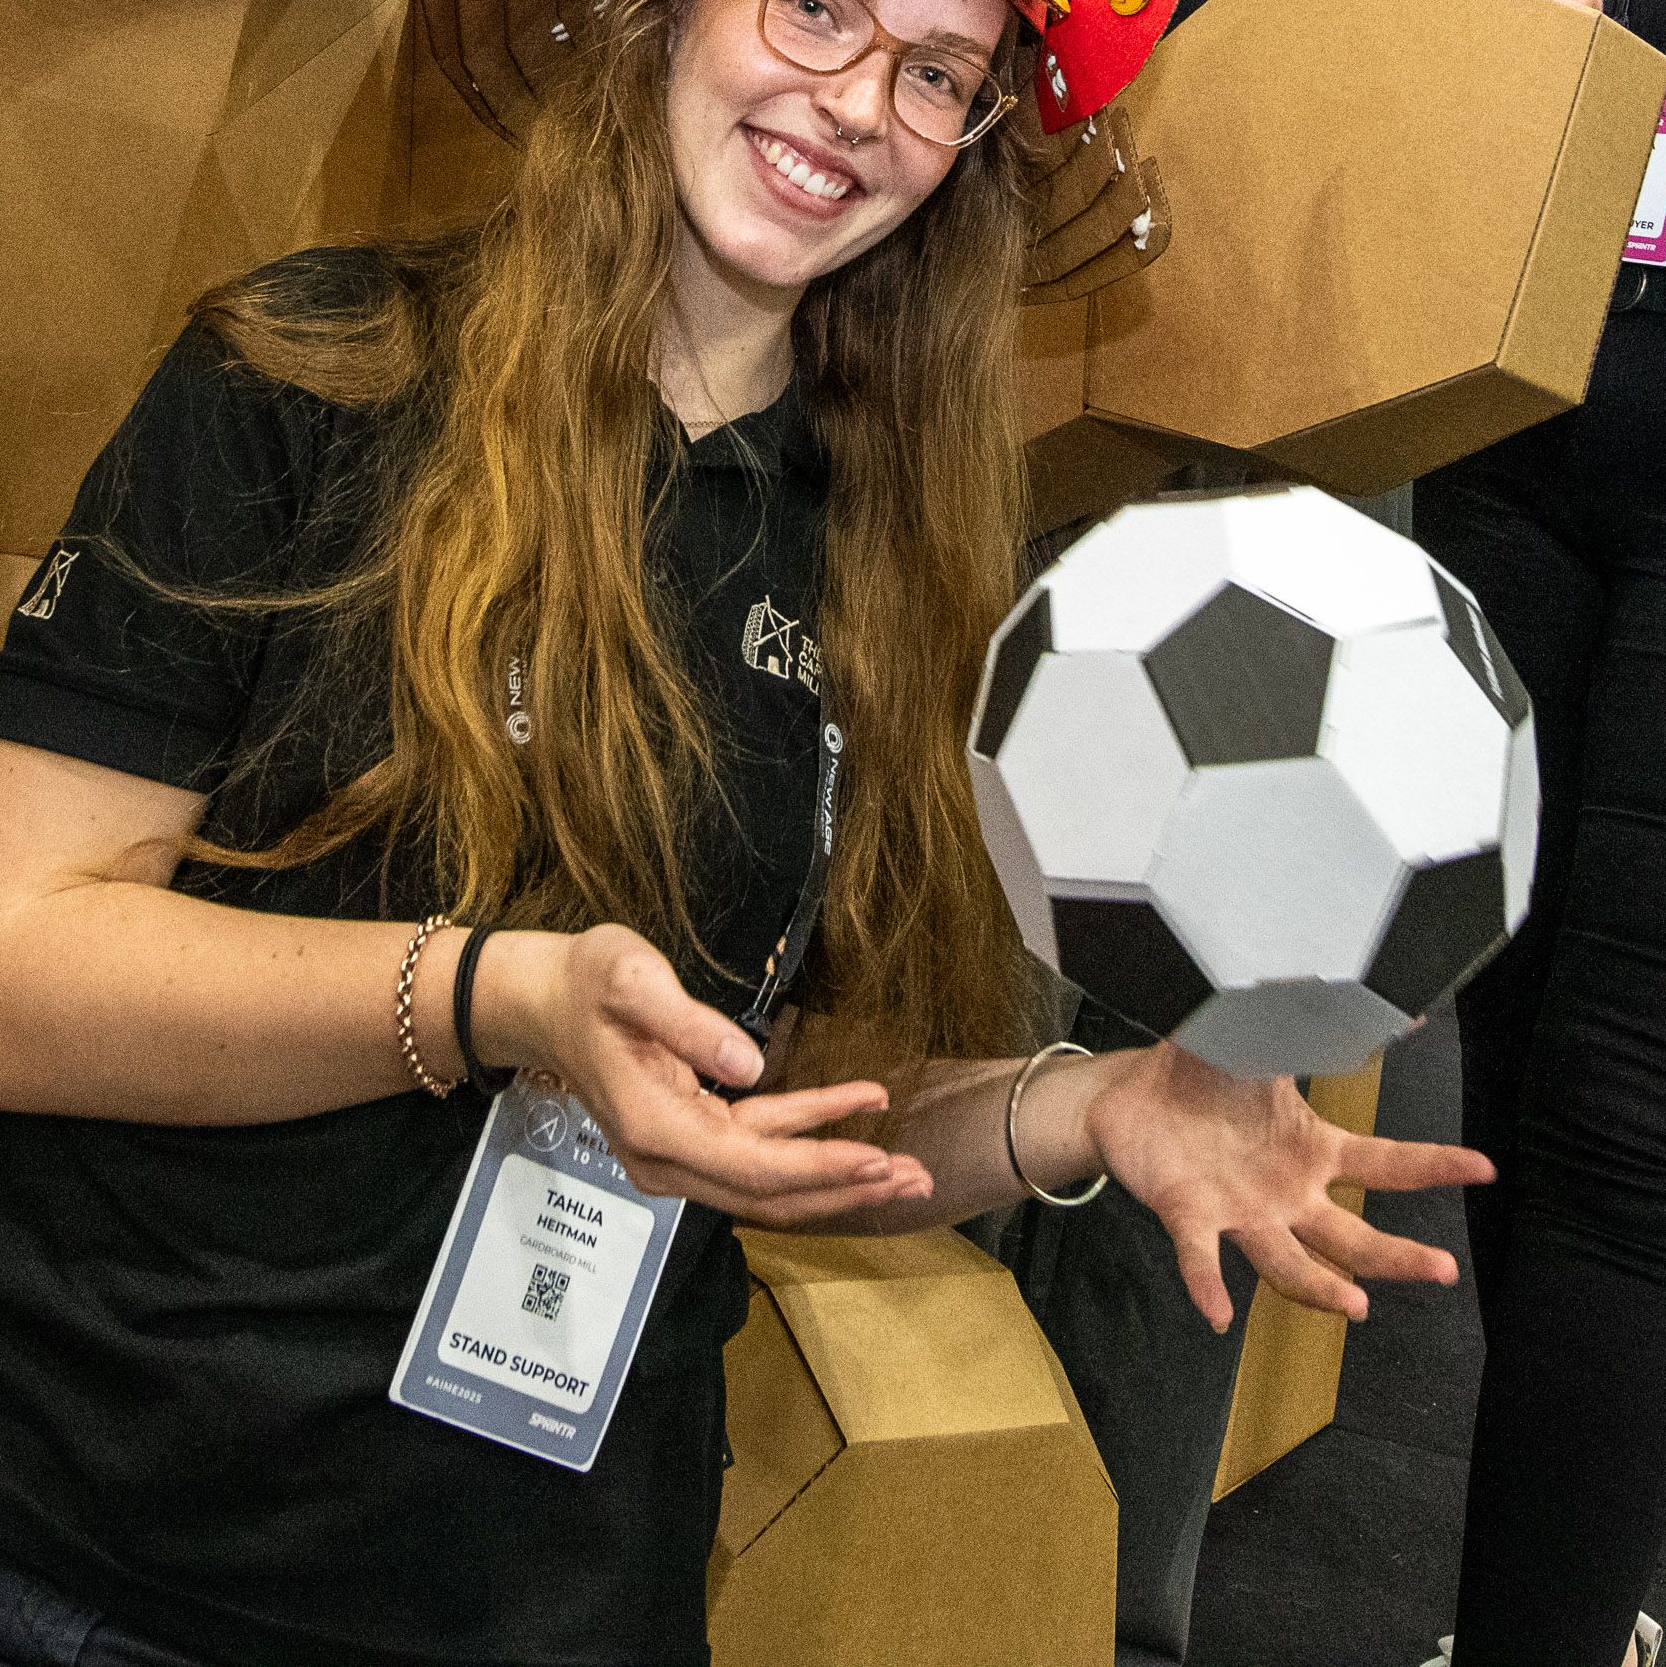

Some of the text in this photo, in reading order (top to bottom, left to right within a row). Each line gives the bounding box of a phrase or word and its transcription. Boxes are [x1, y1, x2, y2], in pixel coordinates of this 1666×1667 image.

[508, 656, 523, 706] NEW
[581, 1116, 602, 1135] AI
[573, 1146, 591, 1165] 10
[547, 1189, 604, 1227] TAHLIA
[536, 1213, 597, 1248] HEITMAN
[519, 1234, 597, 1275] CARDBOARD MILL
[450, 1332, 590, 1397] STAND SUPPORT
